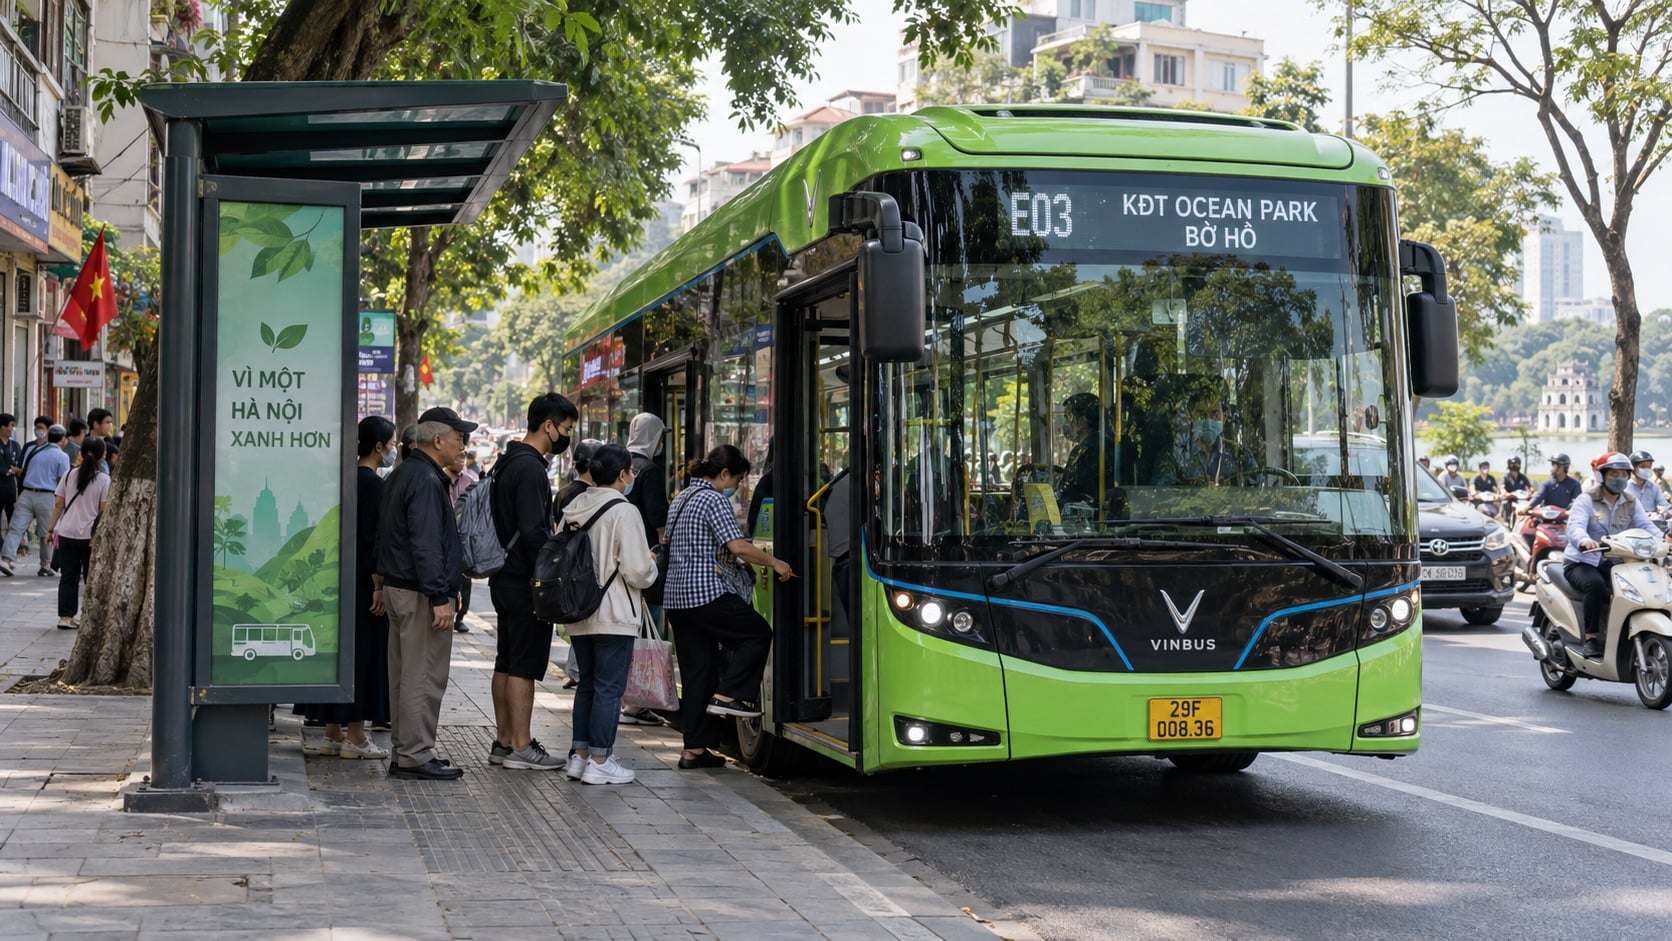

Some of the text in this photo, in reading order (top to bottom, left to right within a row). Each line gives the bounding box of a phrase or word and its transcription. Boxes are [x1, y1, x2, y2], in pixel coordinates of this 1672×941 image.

[1011, 192, 1073, 238] E03
[1123, 193, 1318, 222] KĐT OCEAN PARK
[1185, 220, 1257, 249] BỜ HỒ
[232, 365, 306, 393] VÌ MỘT
[232, 397, 303, 425] HÀ NỘI
[231, 430, 331, 448] XANH HƠN
[1150, 638, 1216, 651] VINBUS
[1170, 700, 1201, 718] 29F
[1157, 720, 1214, 738] 008.36
